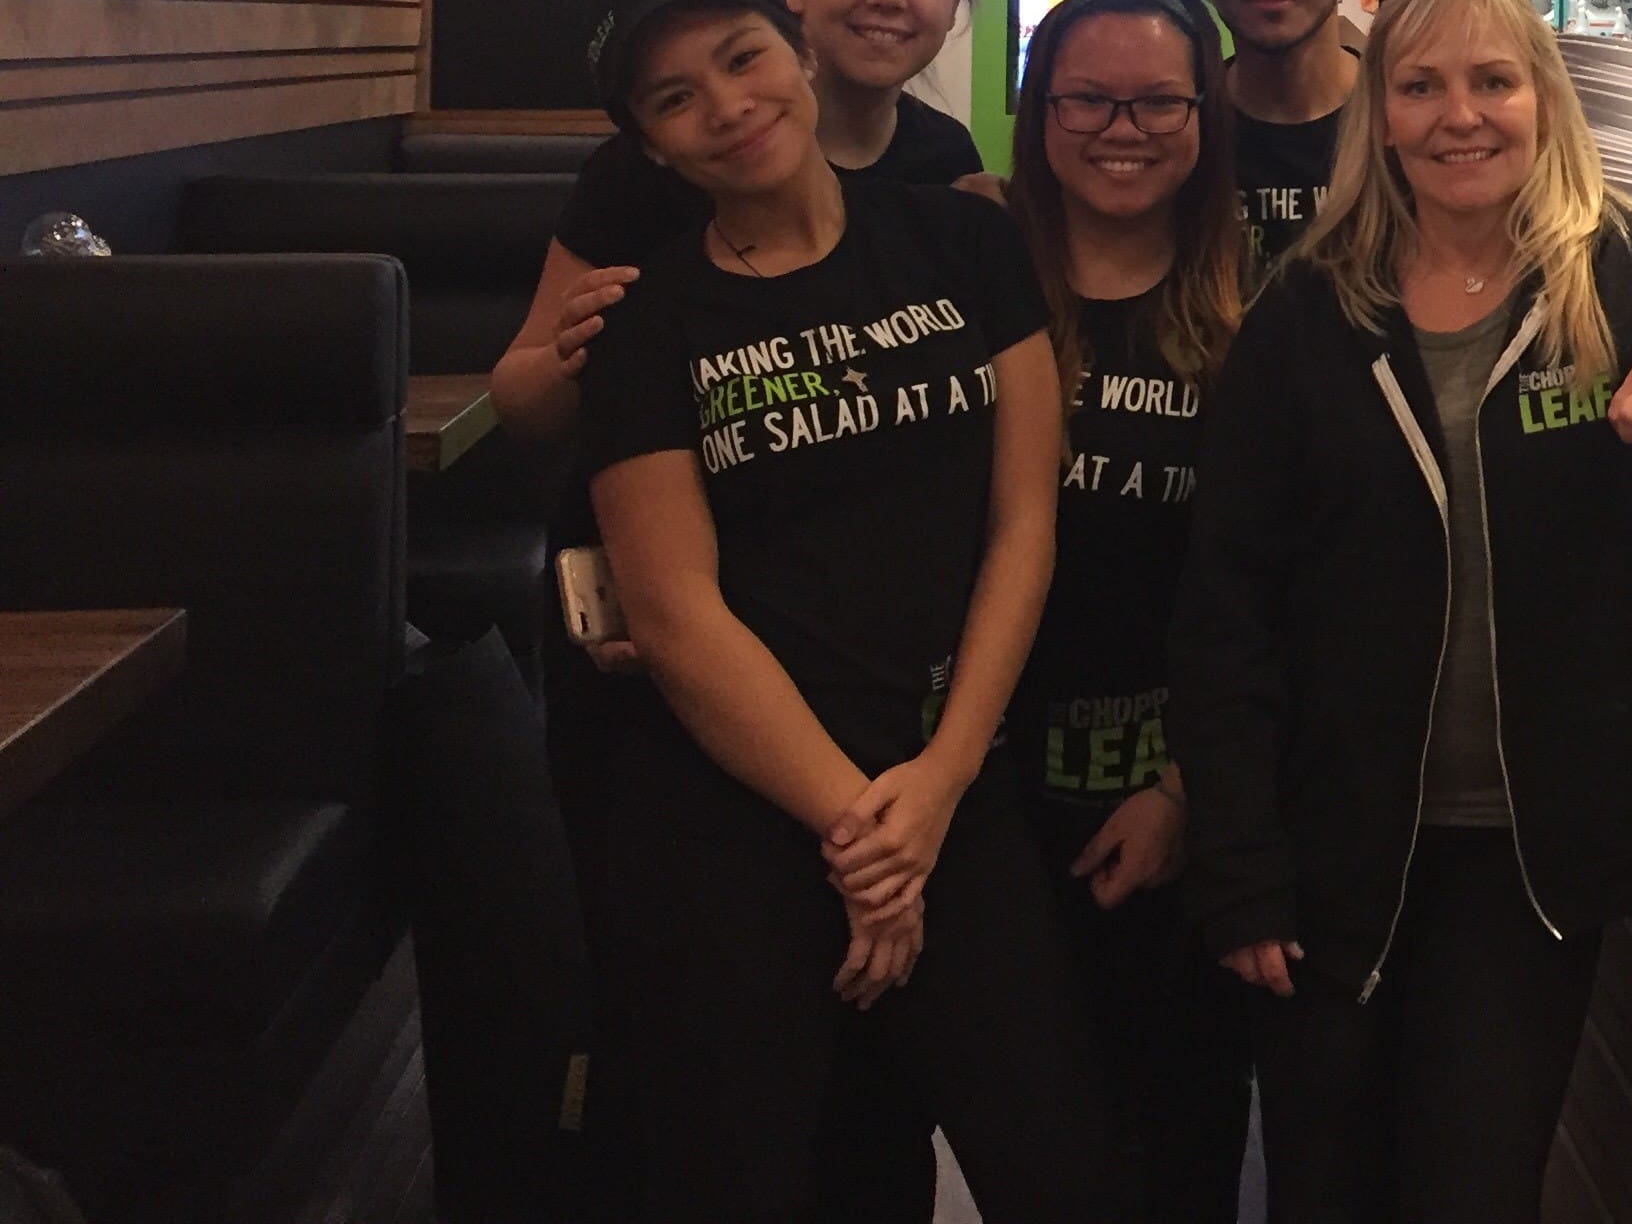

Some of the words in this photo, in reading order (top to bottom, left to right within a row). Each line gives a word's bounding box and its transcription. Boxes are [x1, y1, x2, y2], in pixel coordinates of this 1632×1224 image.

[1256, 188, 1303, 220] THE
[800, 324, 867, 367] THE
[864, 298, 965, 349] WORLD
[702, 420, 754, 474] ONE
[764, 394, 879, 453] SALAD
[895, 383, 929, 425] AT
[948, 375, 970, 414] A
[974, 362, 996, 405] TI
[1100, 374, 1200, 418] WORLD
[1519, 374, 1612, 434] LEAF
[1063, 453, 1110, 491] AT
[1120, 462, 1143, 498] A
[1069, 687, 1169, 729] CHOPP
[1044, 718, 1172, 791] LEA
